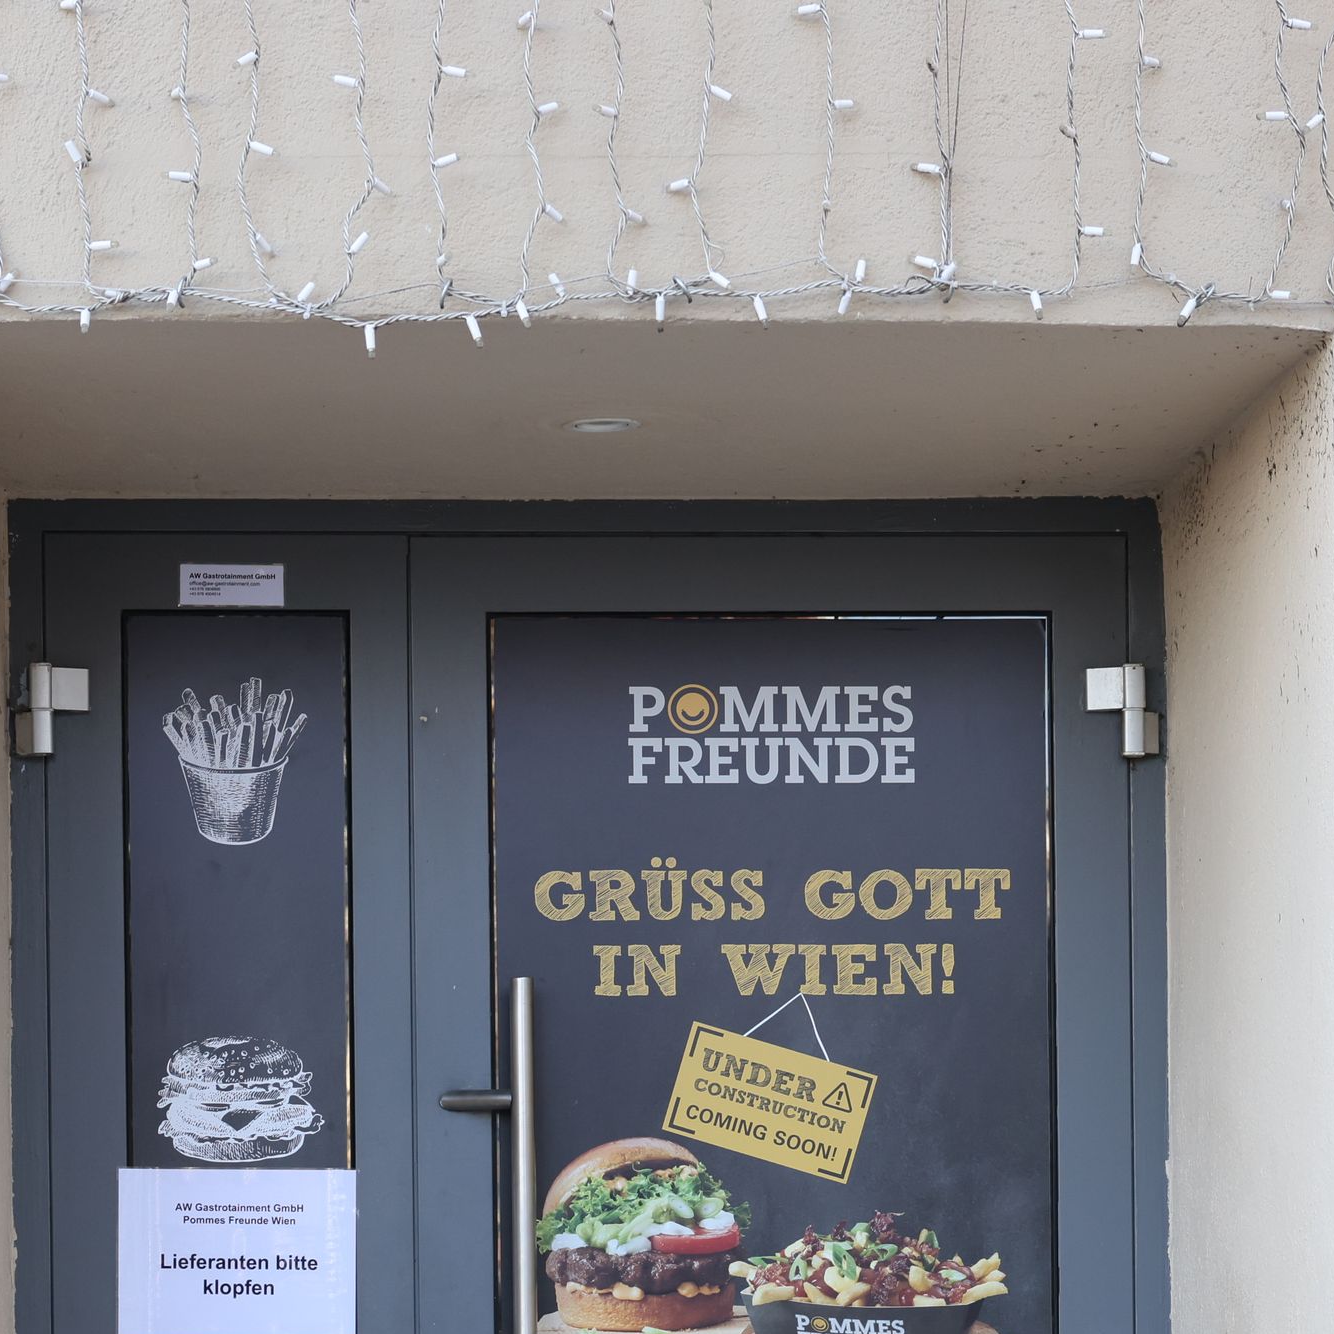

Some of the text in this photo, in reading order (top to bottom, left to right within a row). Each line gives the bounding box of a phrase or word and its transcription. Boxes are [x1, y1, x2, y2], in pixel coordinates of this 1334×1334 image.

[628, 684, 913, 734] POMMES
[628, 737, 915, 784] FREUNDE
[534, 857, 1011, 921] GRÜSS GOTT
[593, 943, 955, 997] IN WIEN!
[701, 1047, 816, 1103] UNDER
[693, 1078, 846, 1134] CONSTRUCTION
[686, 1104, 838, 1162] COMING SOON!
[183, 1216, 296, 1225] Pommes Freunde Wien
[195, 1204, 270, 1212] Gastrotainment
[274, 1204, 304, 1212] GmbH
[160, 1254, 318, 1271] Lieferanten bitte
[203, 1280, 274, 1298] klopfen
